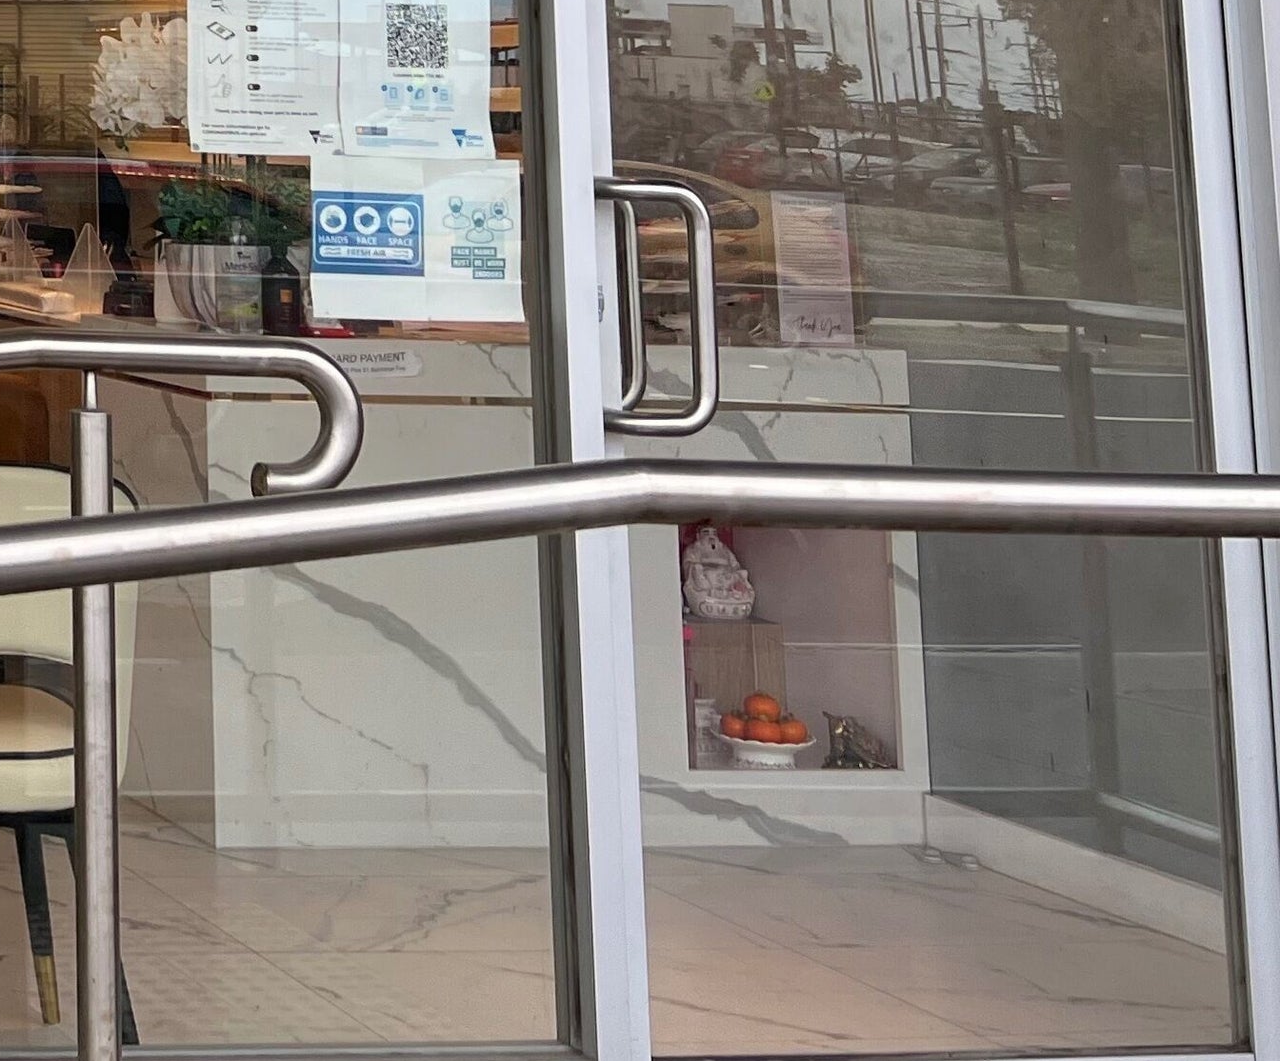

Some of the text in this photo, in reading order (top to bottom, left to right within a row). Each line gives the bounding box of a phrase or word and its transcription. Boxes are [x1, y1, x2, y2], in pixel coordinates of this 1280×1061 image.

[318, 235, 414, 247] HANDS FACE SPACE
[346, 248, 387, 257] FRESH AIR
[360, 351, 406, 363] PAYMENT
